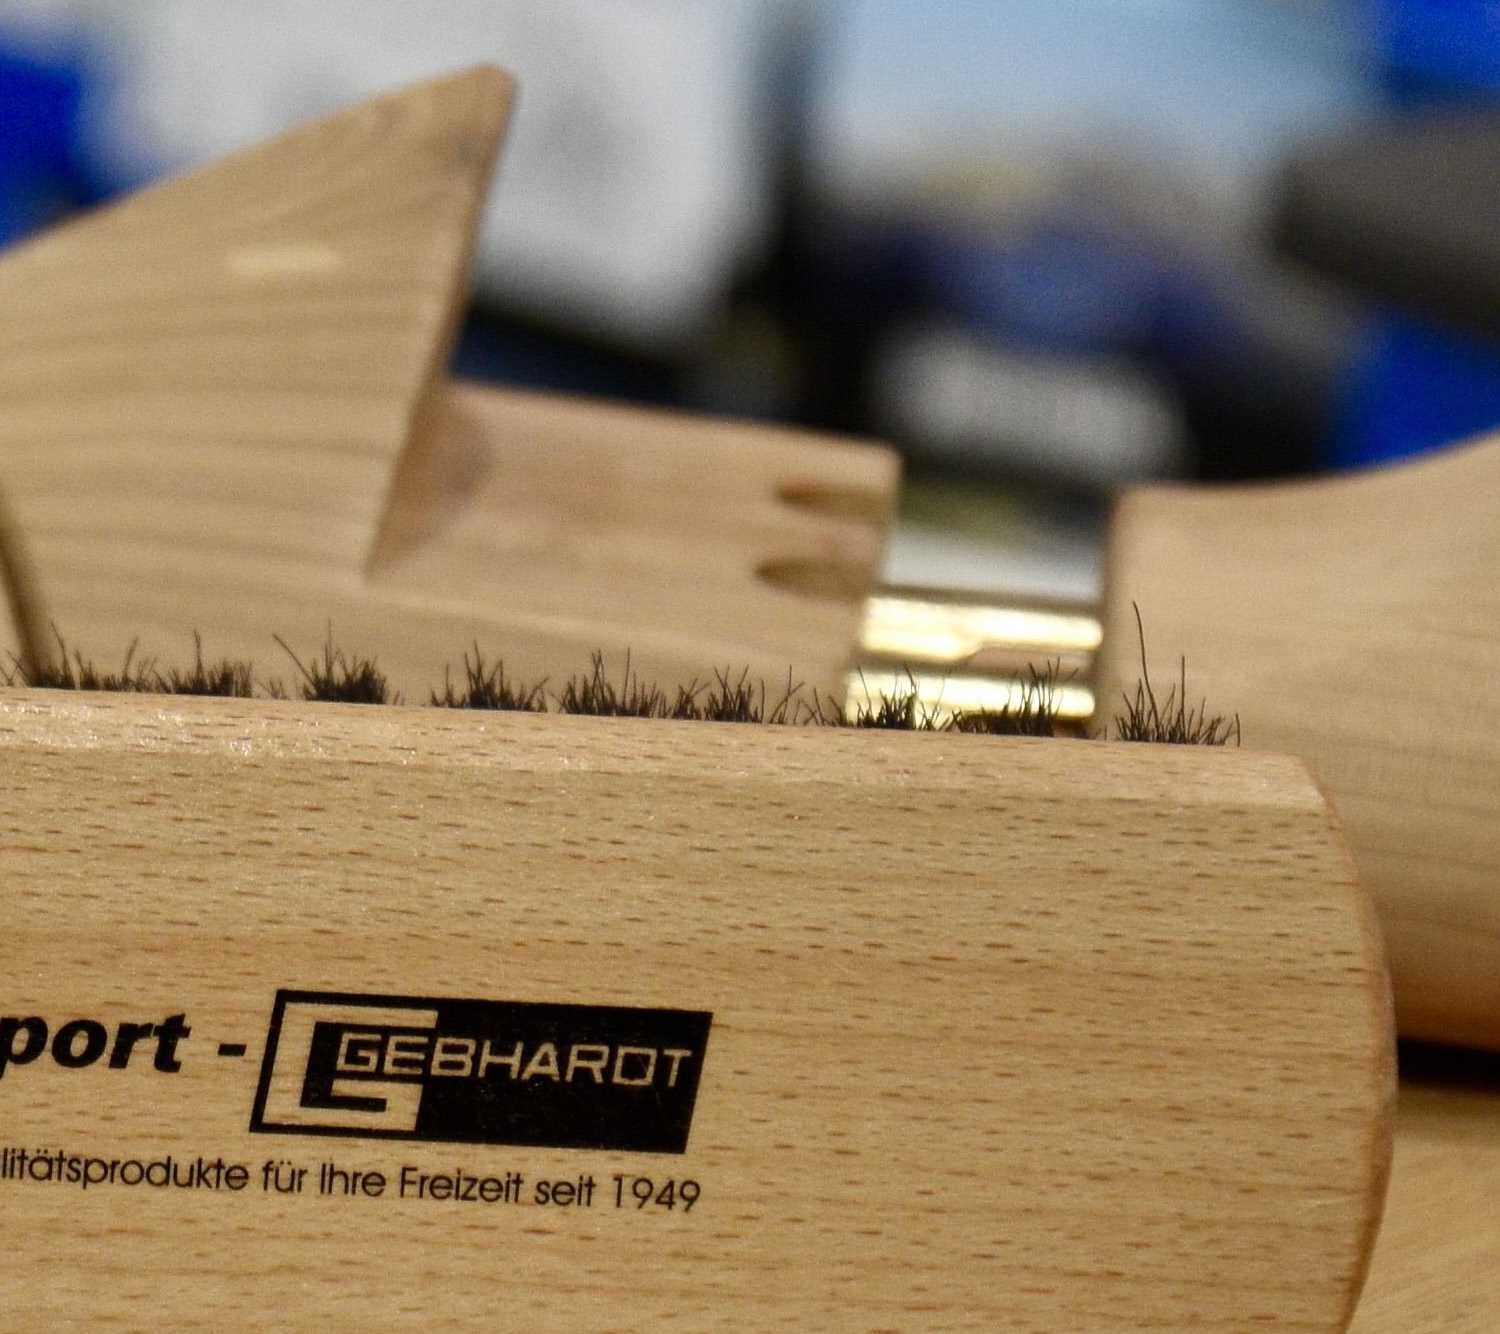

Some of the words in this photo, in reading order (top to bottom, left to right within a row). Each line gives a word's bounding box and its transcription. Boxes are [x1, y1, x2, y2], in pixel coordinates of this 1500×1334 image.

[334, 1030, 693, 1088] GEBHARDT
[261, 1159, 309, 1195] für
[319, 1161, 388, 1198] Ihre
[398, 1165, 525, 1205] Freizeit
[533, 1174, 598, 1208] seit
[612, 1173, 702, 1214] 1949
